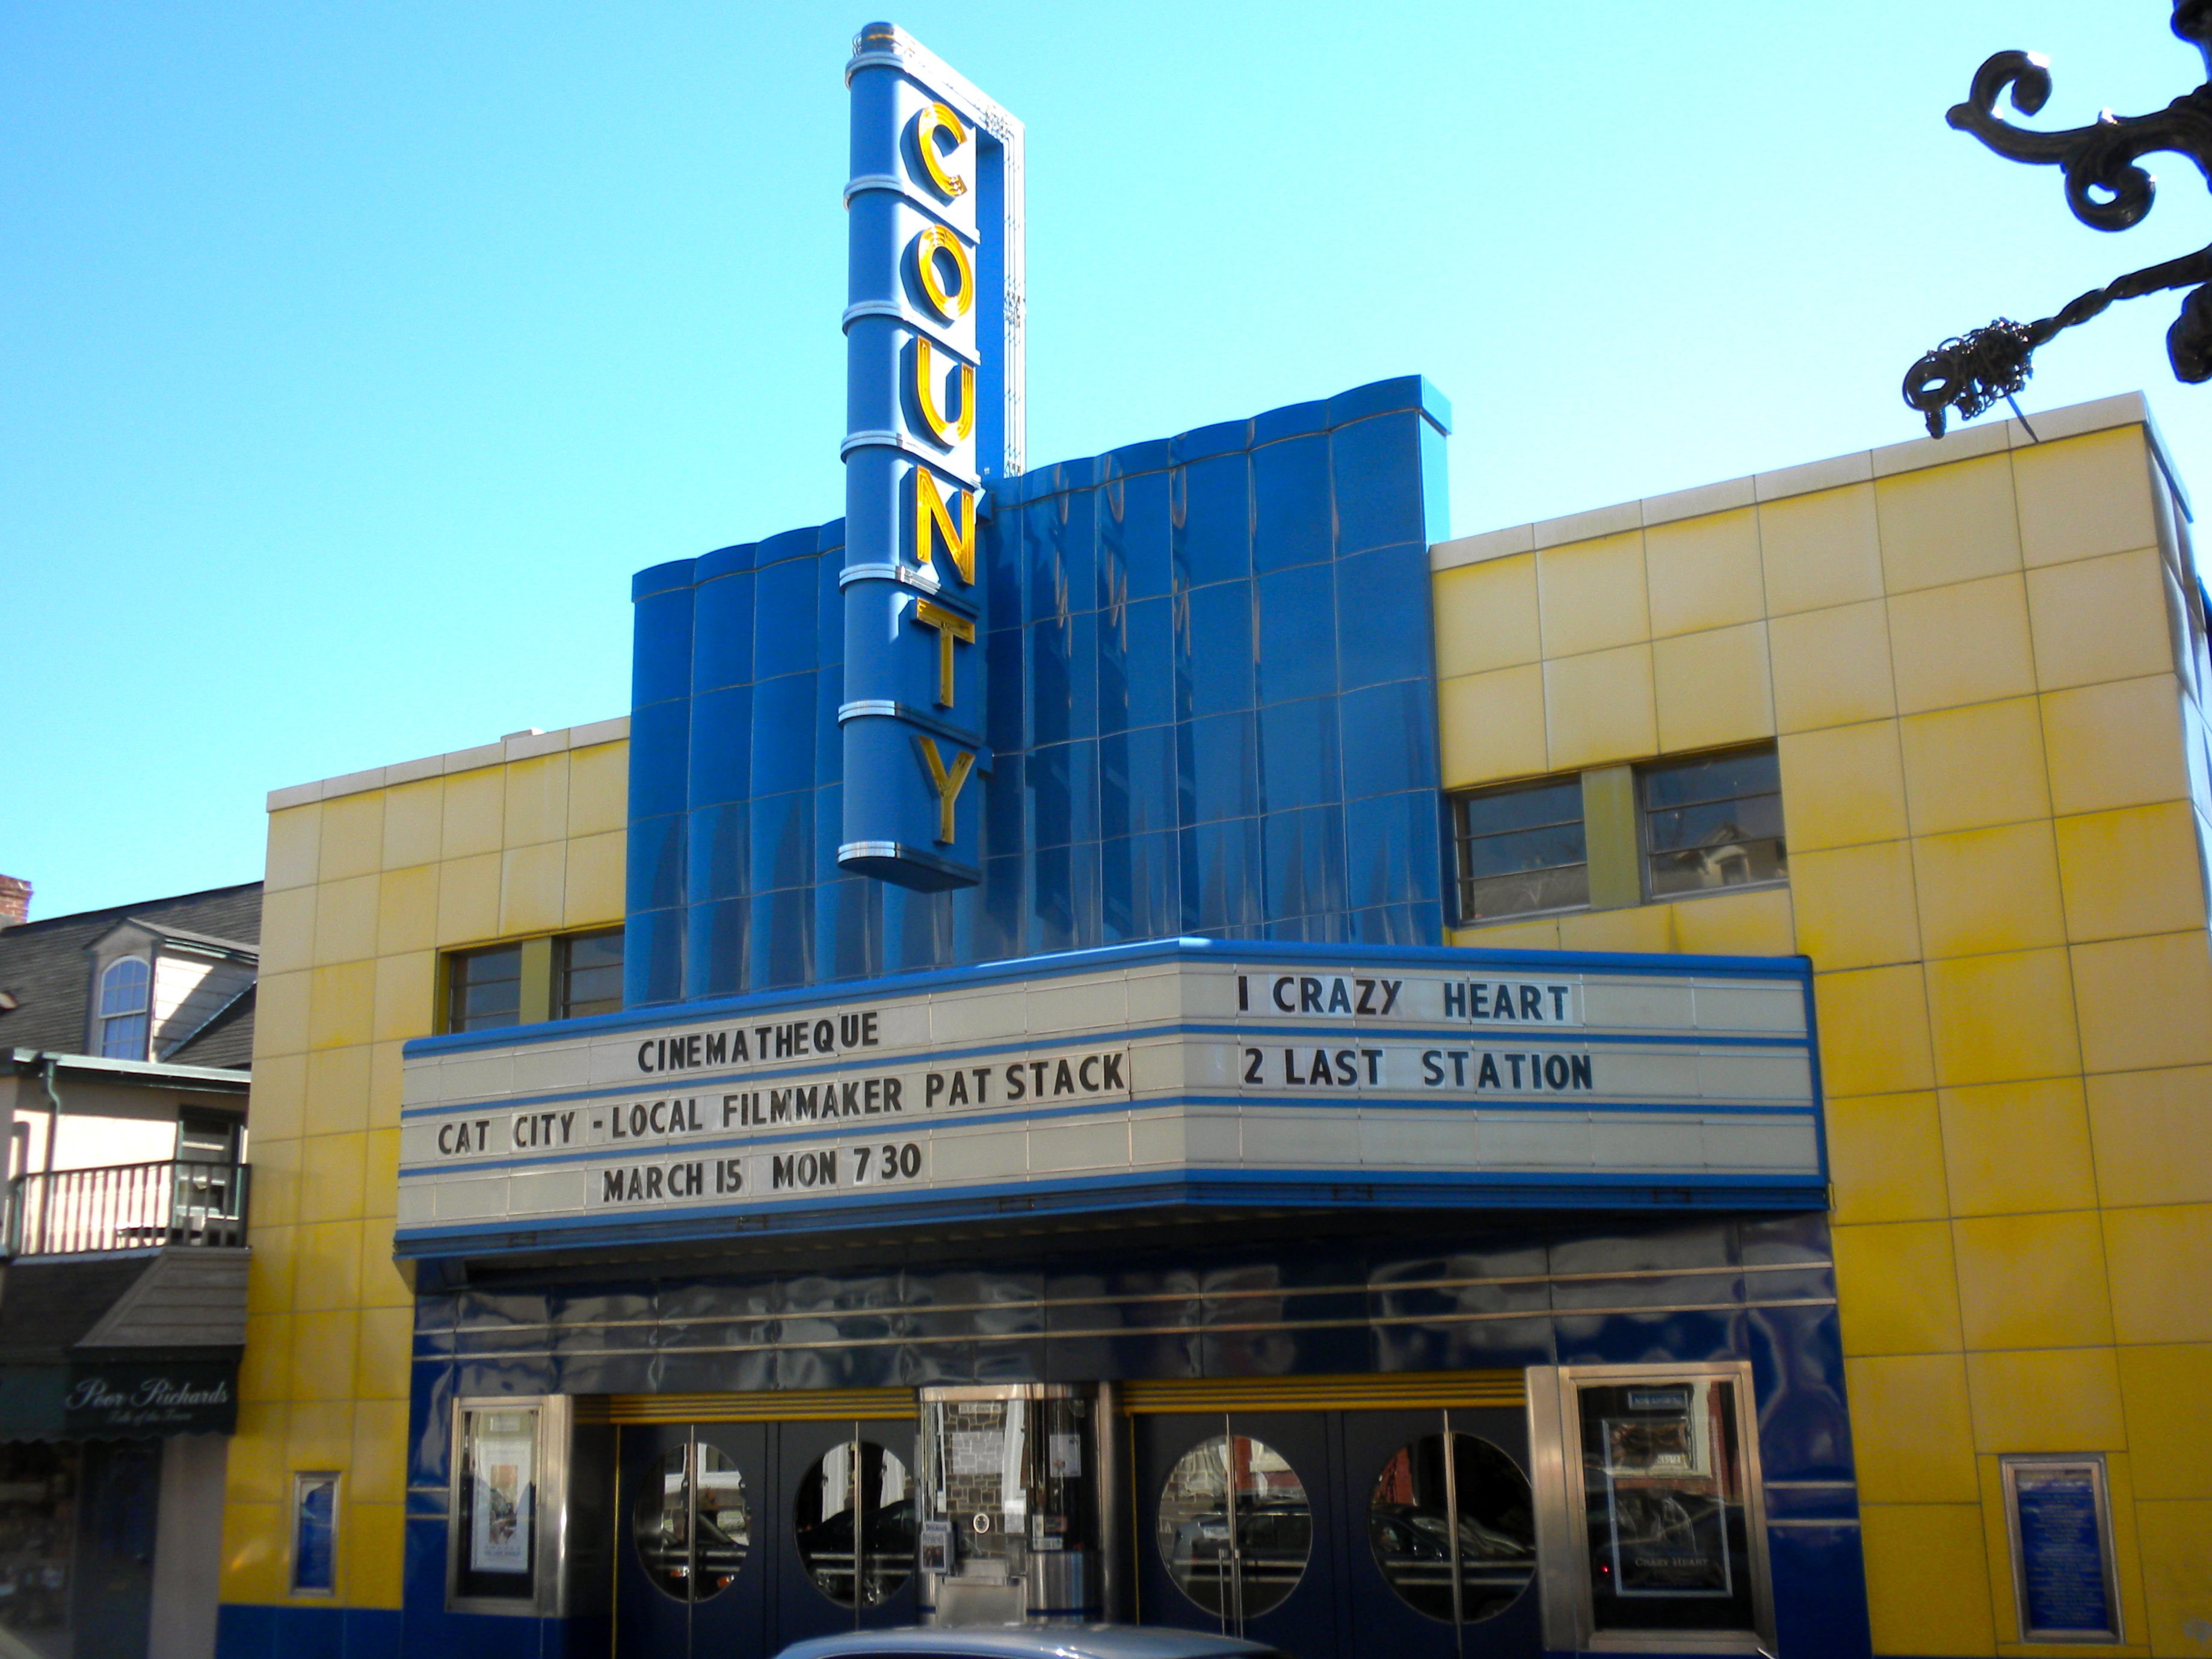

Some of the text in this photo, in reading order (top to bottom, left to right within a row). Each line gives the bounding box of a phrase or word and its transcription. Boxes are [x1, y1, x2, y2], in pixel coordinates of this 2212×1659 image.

[914, 100, 975, 845] COUNTY
[1272, 977, 1402, 1016] CRAZY
[1444, 983, 1568, 1021] HEART
[638, 1012, 878, 1073] CINEMATHEQUE
[1245, 1048, 1592, 1090] 2 LAST STATION
[438, 1120, 490, 1155] CAT
[513, 1111, 575, 1148] CITY
[723, 1078, 902, 1128] FILMMAKER
[925, 1068, 991, 1108] PAT
[1007, 1053, 1124, 1101] STACK
[603, 1163, 703, 1202] MARCH
[716, 1159, 742, 1193] 15
[772, 1151, 836, 1188] MON
[65, 1377, 125, 1409] Poor
